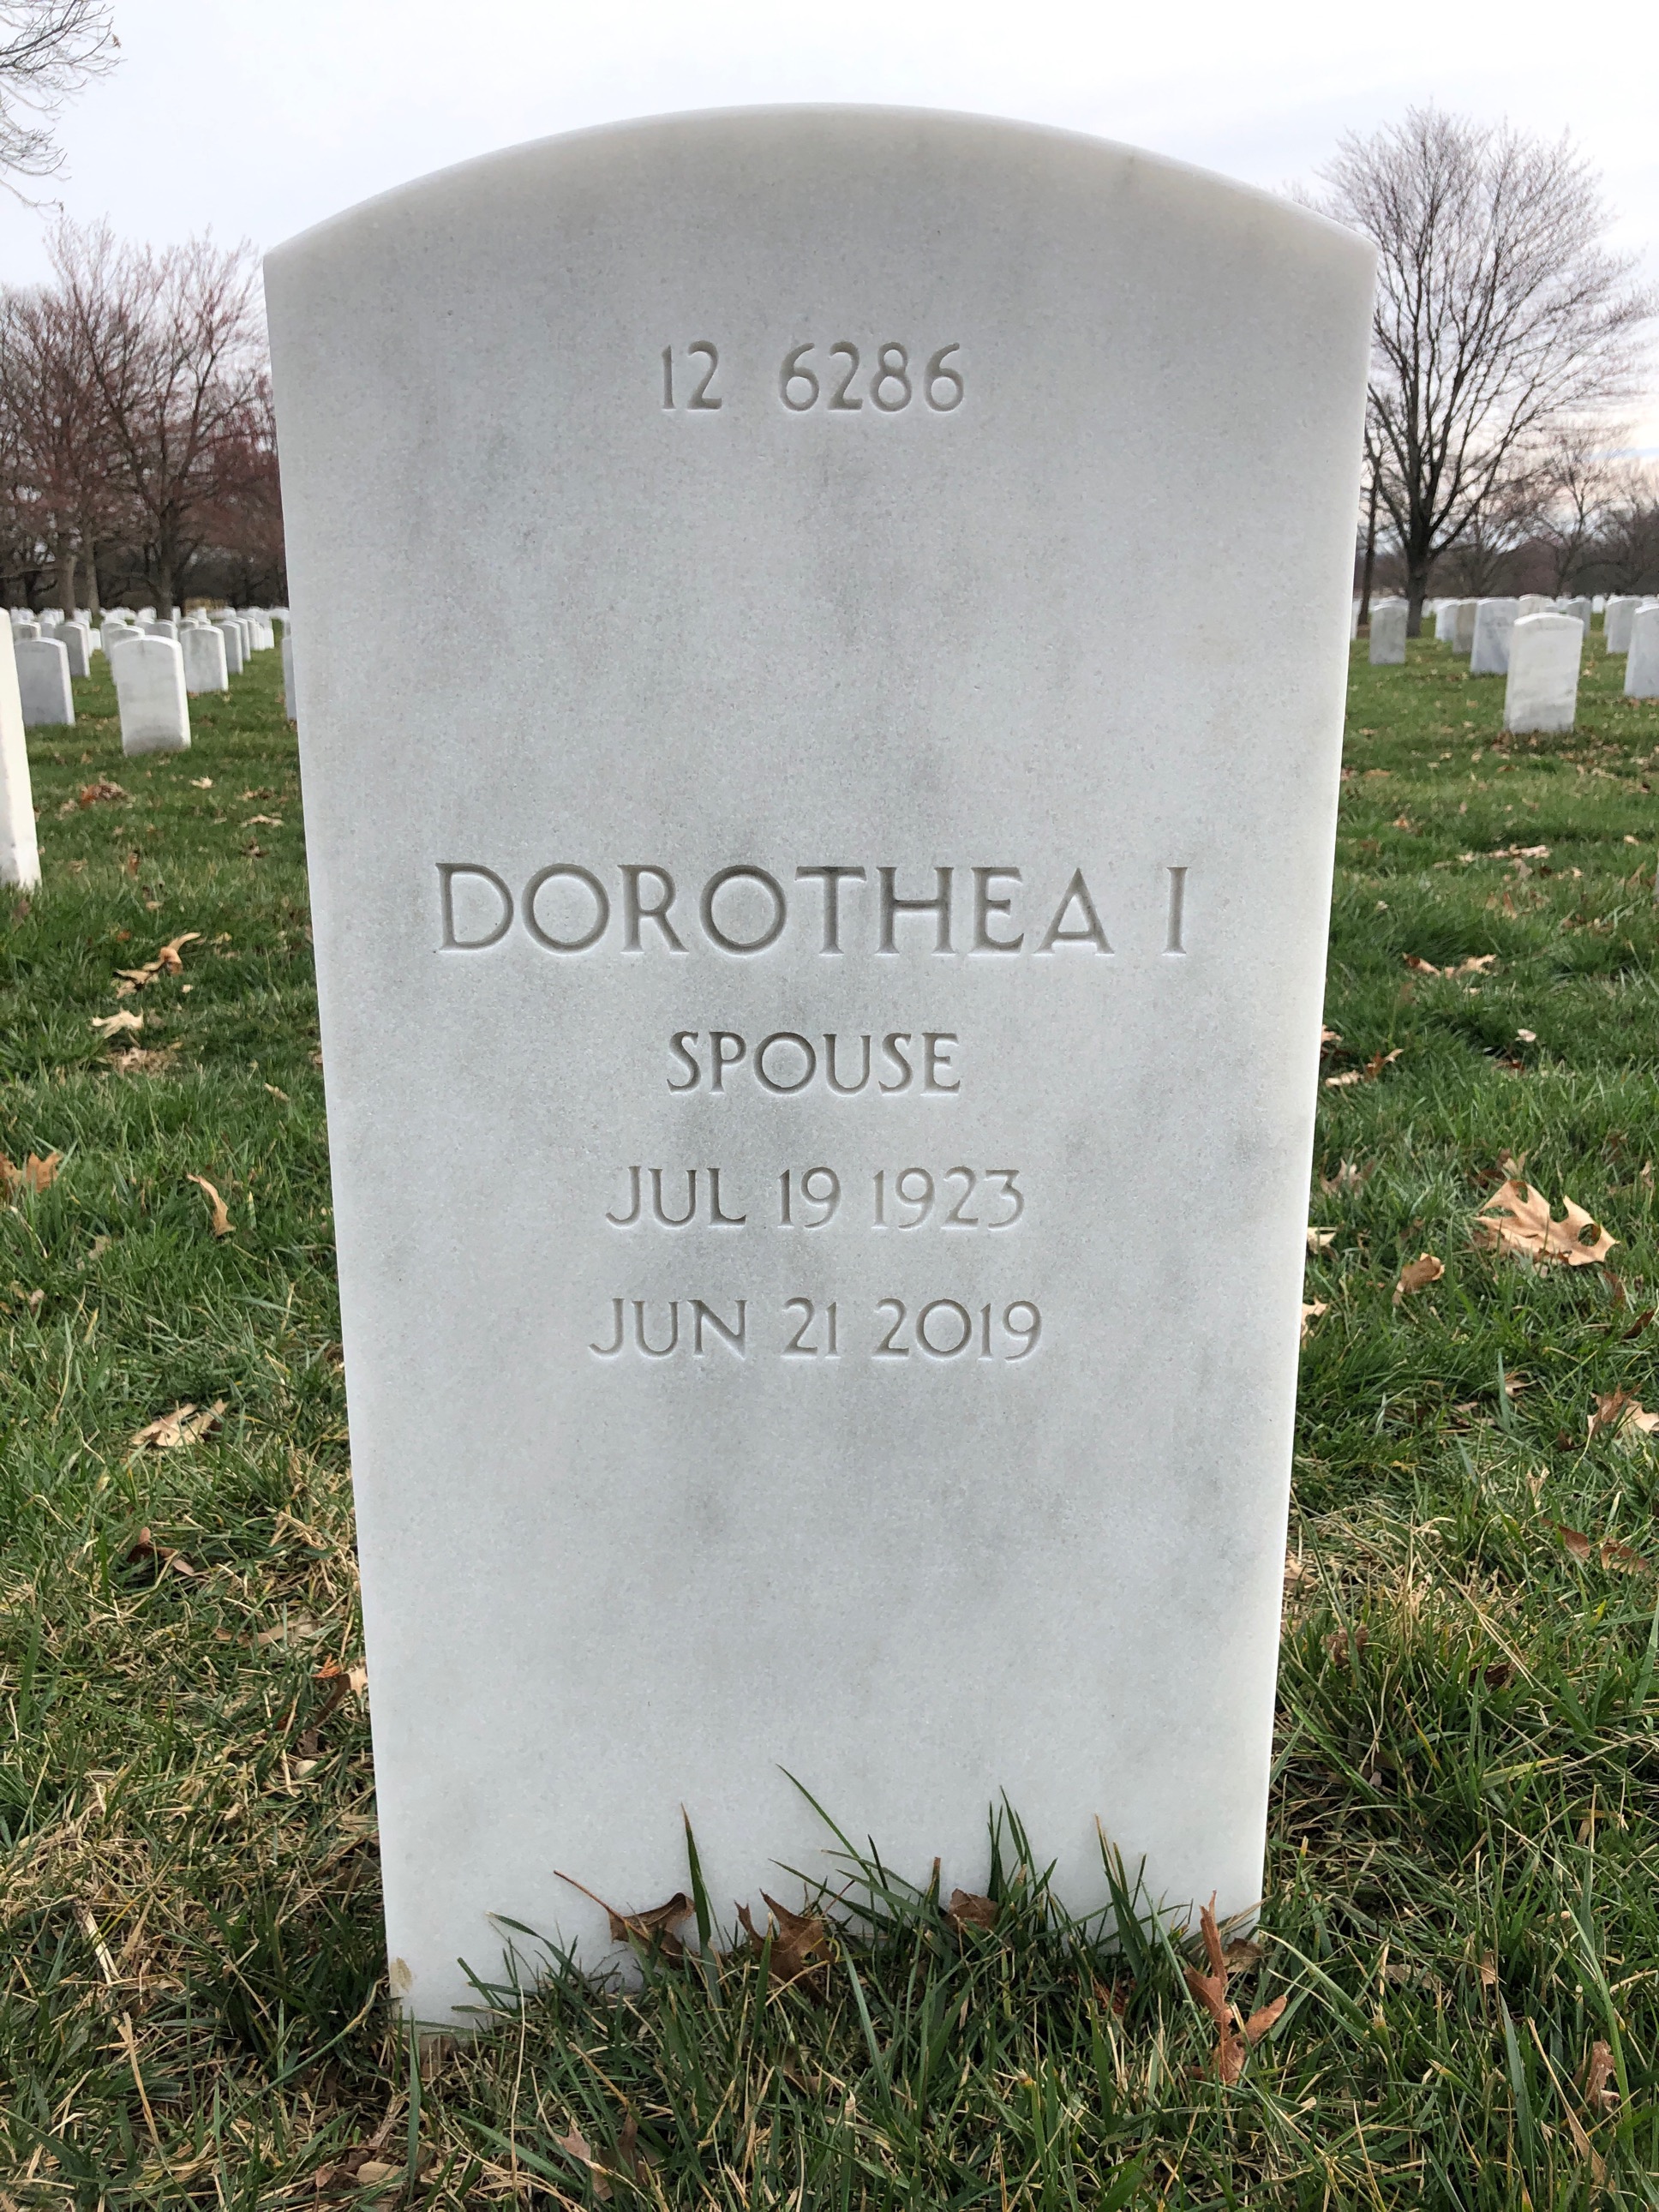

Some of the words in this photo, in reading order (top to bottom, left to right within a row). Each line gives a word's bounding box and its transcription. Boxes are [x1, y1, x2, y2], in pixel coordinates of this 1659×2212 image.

[661, 340, 722, 411] 12
[778, 341, 965, 413] 6286
[434, 861, 1116, 956] DOROTHEA
[1161, 866, 1189, 956] I
[666, 1031, 961, 1095] SPOUSE
[605, 1166, 747, 1229] JUL
[777, 1166, 841, 1229] 19
[871, 1166, 1026, 1231] 1923
[588, 1298, 748, 1359] JUN
[780, 1297, 841, 1359] 21
[871, 1298, 1043, 1361] 2019
